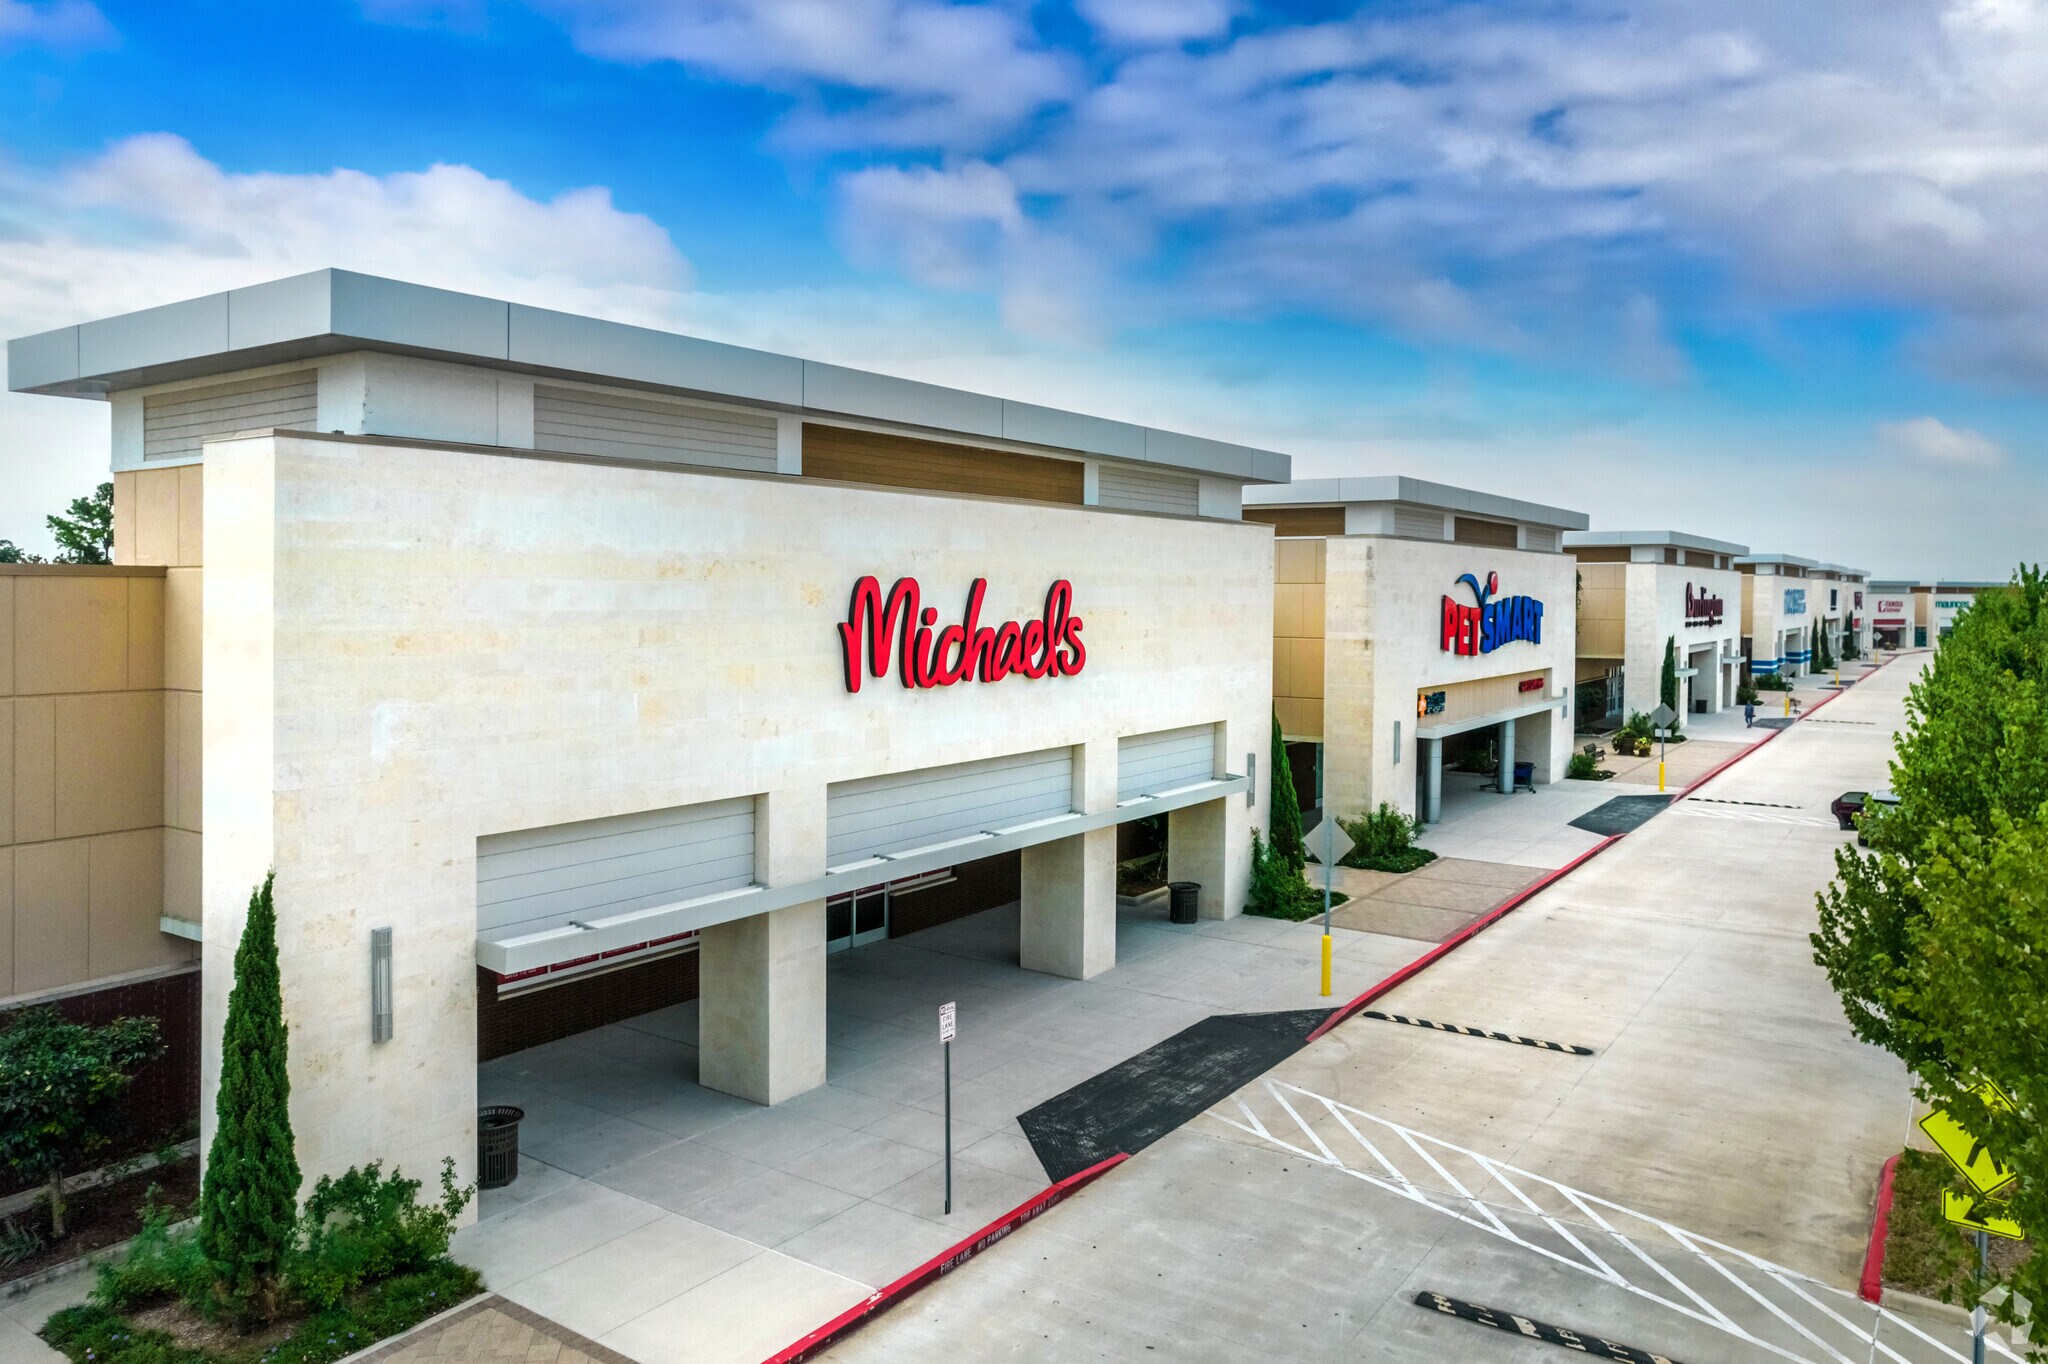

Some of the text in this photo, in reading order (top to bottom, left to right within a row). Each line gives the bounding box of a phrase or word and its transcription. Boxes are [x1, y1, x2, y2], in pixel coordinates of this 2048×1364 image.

[837, 575, 1087, 694] Michaels
[1440, 594, 1544, 657] PETSMART
[942, 1013, 953, 1022] FIRE
[942, 1020, 954, 1030] LANE
[940, 1257, 954, 1275] FIRE
[955, 1247, 972, 1265] LANE
[977, 1239, 986, 1252] NO
[987, 1223, 1012, 1245] PARKING
[1031, 1199, 1046, 1216] AWAY
